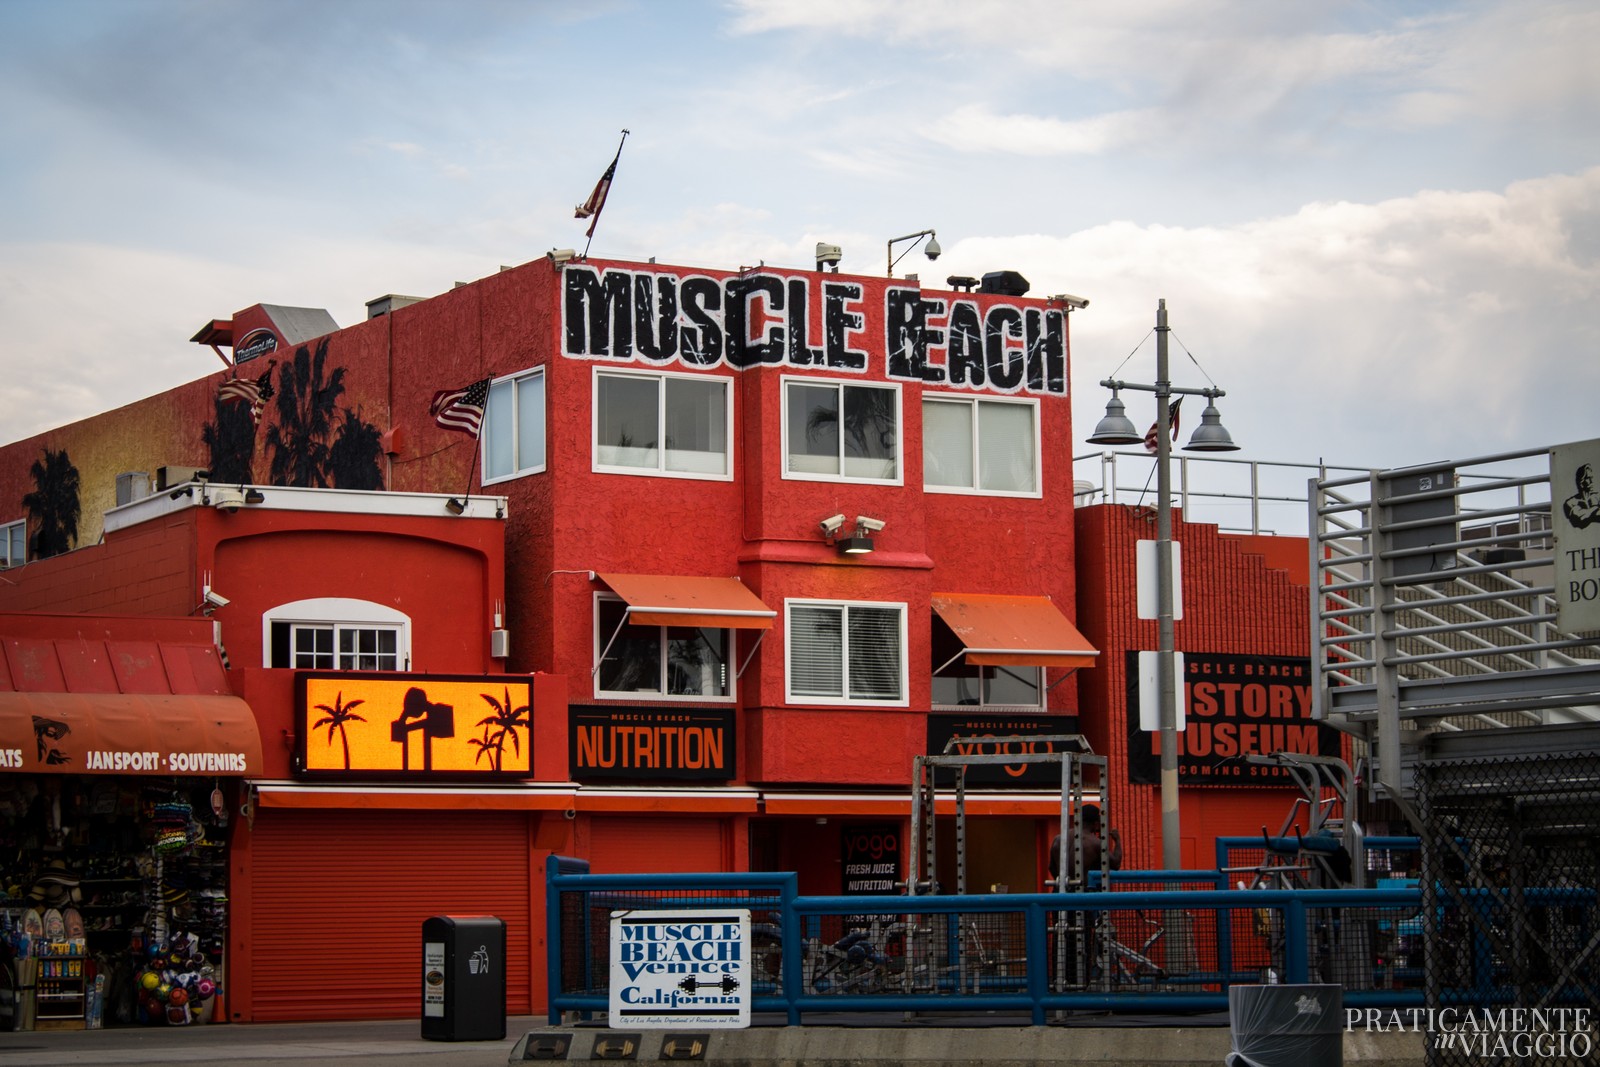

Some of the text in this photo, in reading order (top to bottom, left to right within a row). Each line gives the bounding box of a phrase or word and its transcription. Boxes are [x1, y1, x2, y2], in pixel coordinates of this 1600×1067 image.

[562, 266, 1067, 396] MUSCLE BEACH
[237, 338, 275, 360] ThermoLife
[1566, 547, 1600, 571] TH
[1569, 578, 1600, 602] BO
[1184, 662, 1303, 676] SCLE BEACH
[1184, 681, 1312, 718] ISTORY
[656, 714, 691, 722] BEACH
[576, 725, 724, 769] NUTRITION
[86, 751, 159, 770] JANSPORT
[169, 752, 247, 771] SOUVENIRS
[1179, 765, 1241, 776] COMING
[844, 834, 897, 860] yoga
[846, 863, 896, 875] FRESH JUICE
[848, 880, 893, 891] NUTRITION
[620, 924, 741, 941] MUSCLE
[619, 941, 742, 962] BEACH
[620, 962, 740, 982] Venice
[620, 987, 741, 1008] California
